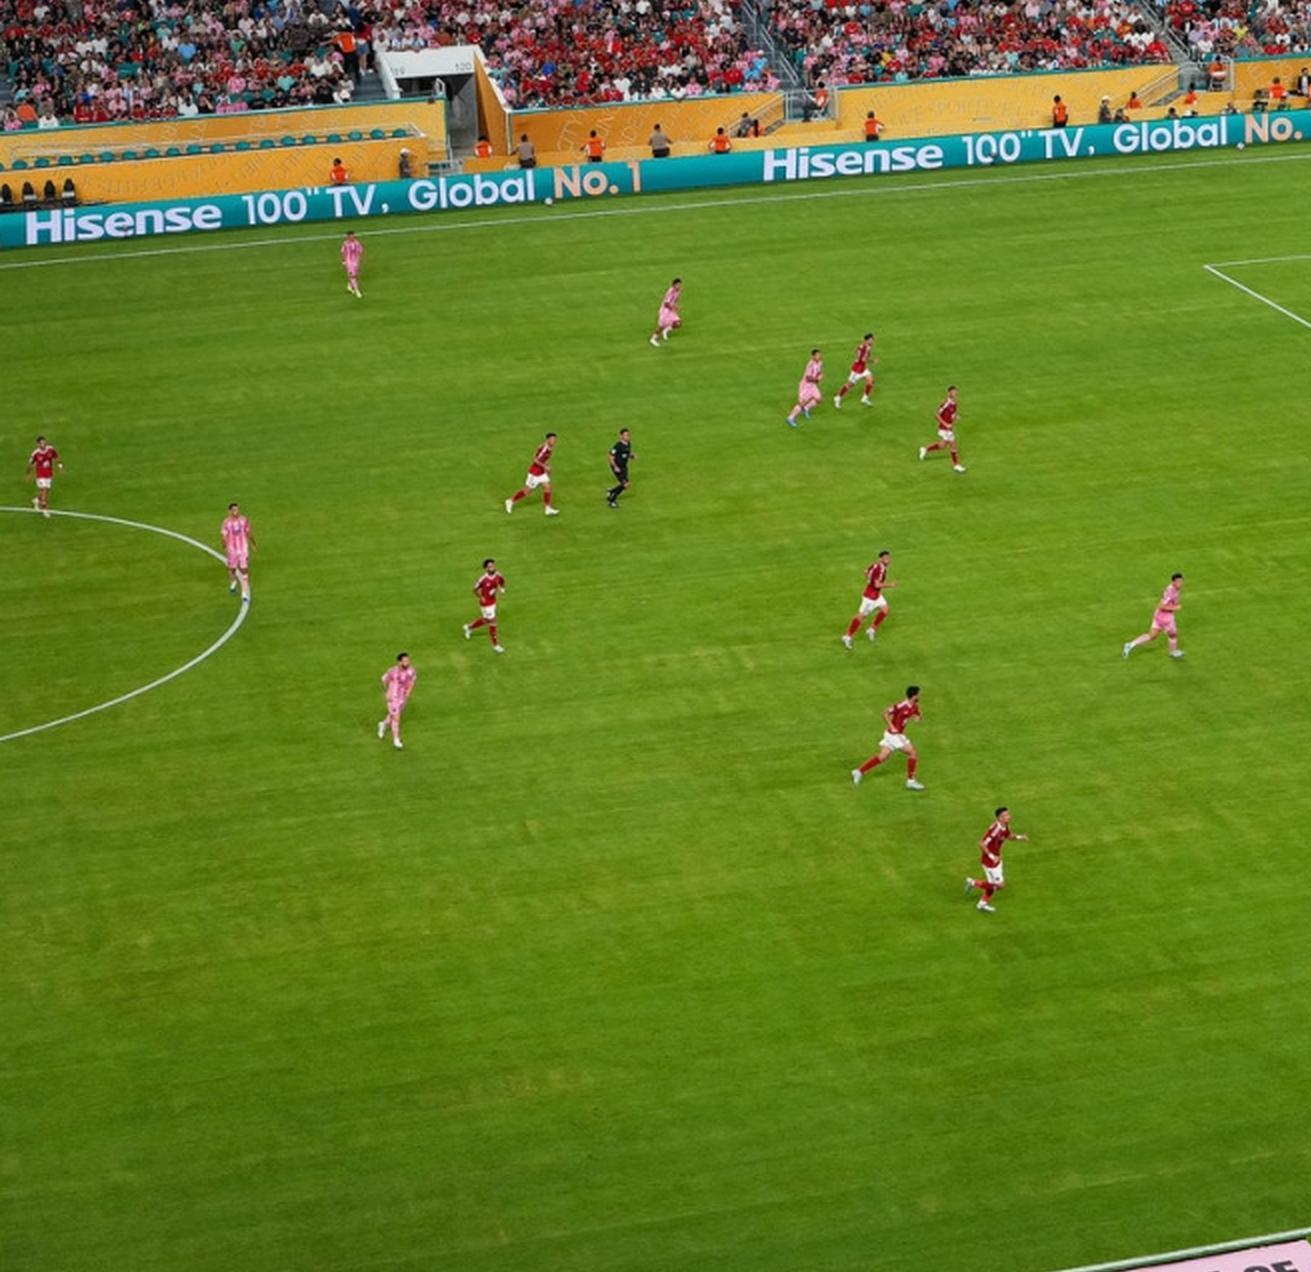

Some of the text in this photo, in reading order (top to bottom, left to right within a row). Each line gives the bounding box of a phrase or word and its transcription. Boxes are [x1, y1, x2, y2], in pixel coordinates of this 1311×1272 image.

[763, 145, 943, 181] Hisense
[1039, 128, 1095, 158] TV,
[1114, 115, 1227, 153] Global
[1245, 113, 1302, 143] No.
[26, 204, 223, 244] Hisense
[243, 187, 319, 226] 100"
[327, 185, 389, 217] TV,
[408, 169, 535, 210] Global
[553, 165, 619, 199] No.
[627, 160, 642, 192] 1
